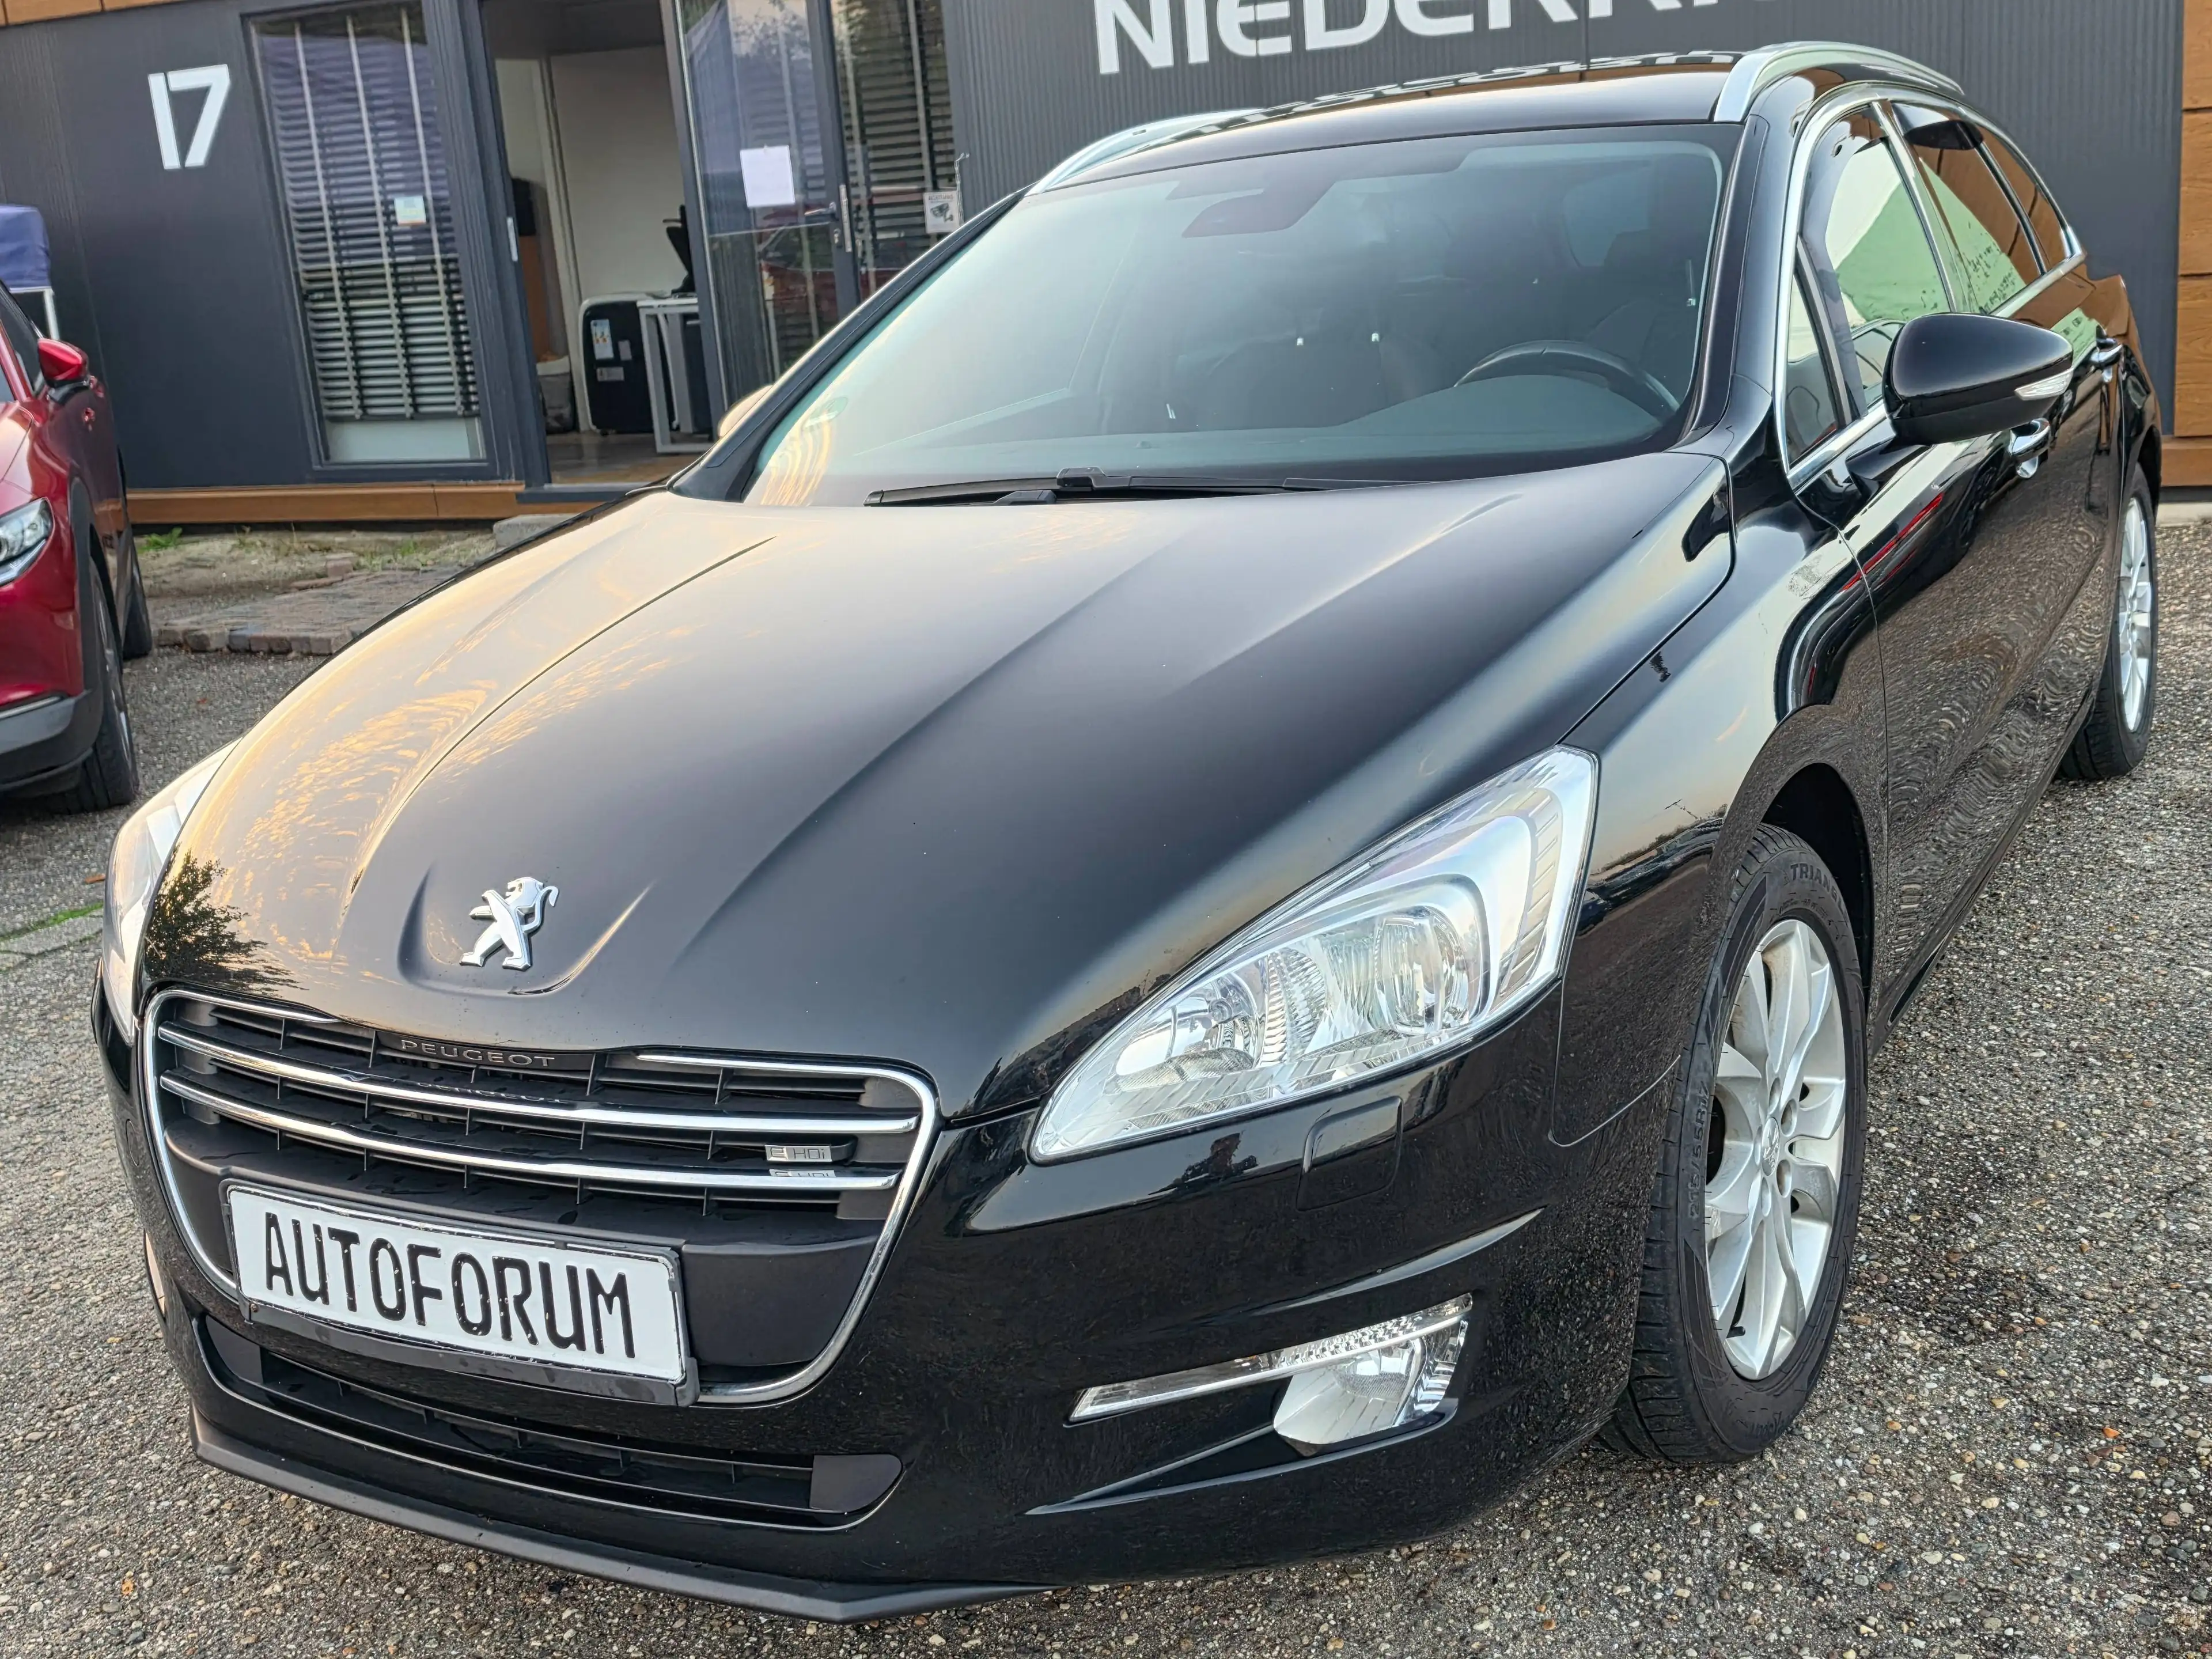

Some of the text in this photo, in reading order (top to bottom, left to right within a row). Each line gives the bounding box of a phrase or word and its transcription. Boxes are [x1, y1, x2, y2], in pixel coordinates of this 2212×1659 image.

[1096, 0, 1778, 74] NIED
[147, 64, 230, 169] 17
[401, 1039, 555, 1067] PEUGEOT
[265, 1211, 635, 1359] AUTOFORUM
